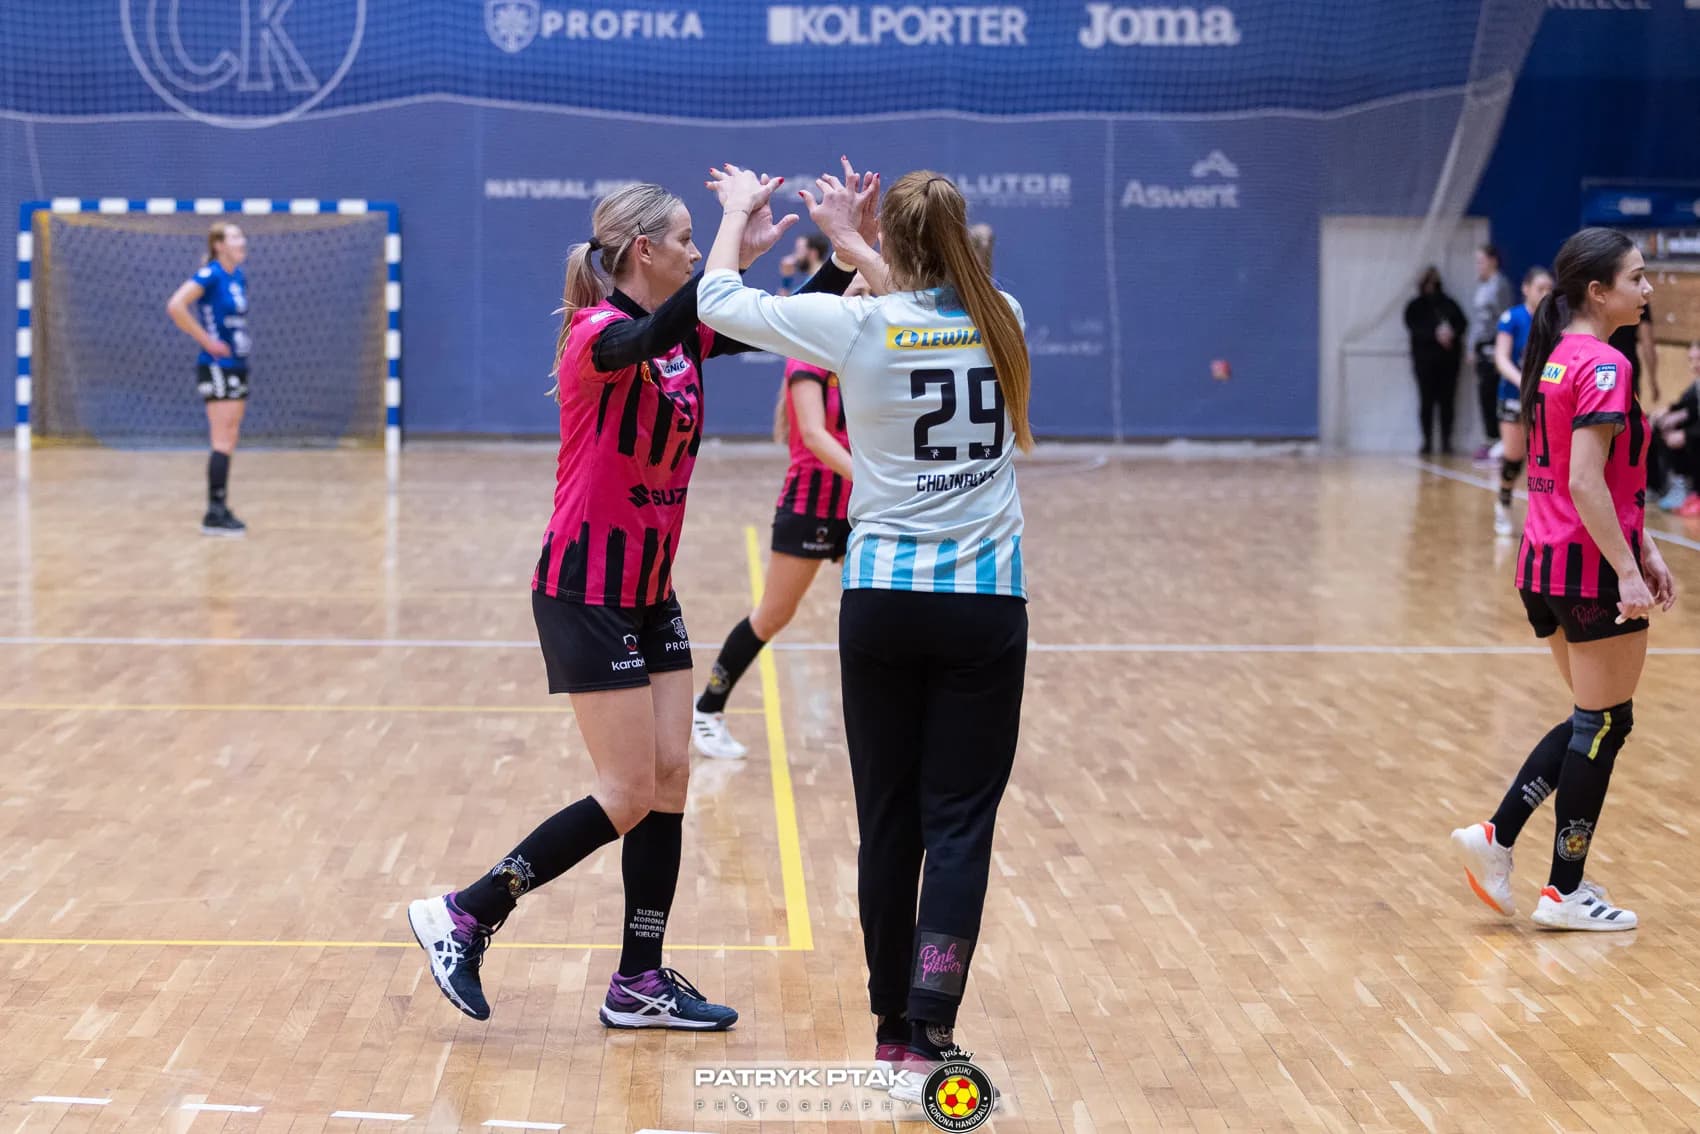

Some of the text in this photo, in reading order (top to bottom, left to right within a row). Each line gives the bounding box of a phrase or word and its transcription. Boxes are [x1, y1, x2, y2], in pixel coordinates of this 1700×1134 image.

[541, 11, 704, 39] PROFIKA
[799, 8, 1028, 45] KOLPORTER
[1079, 3, 1241, 48] Joma
[950, 173, 1072, 195] LUTOR
[664, 361, 686, 374] GNiG
[910, 367, 1005, 461] 29
[920, 943, 957, 963] Pink
